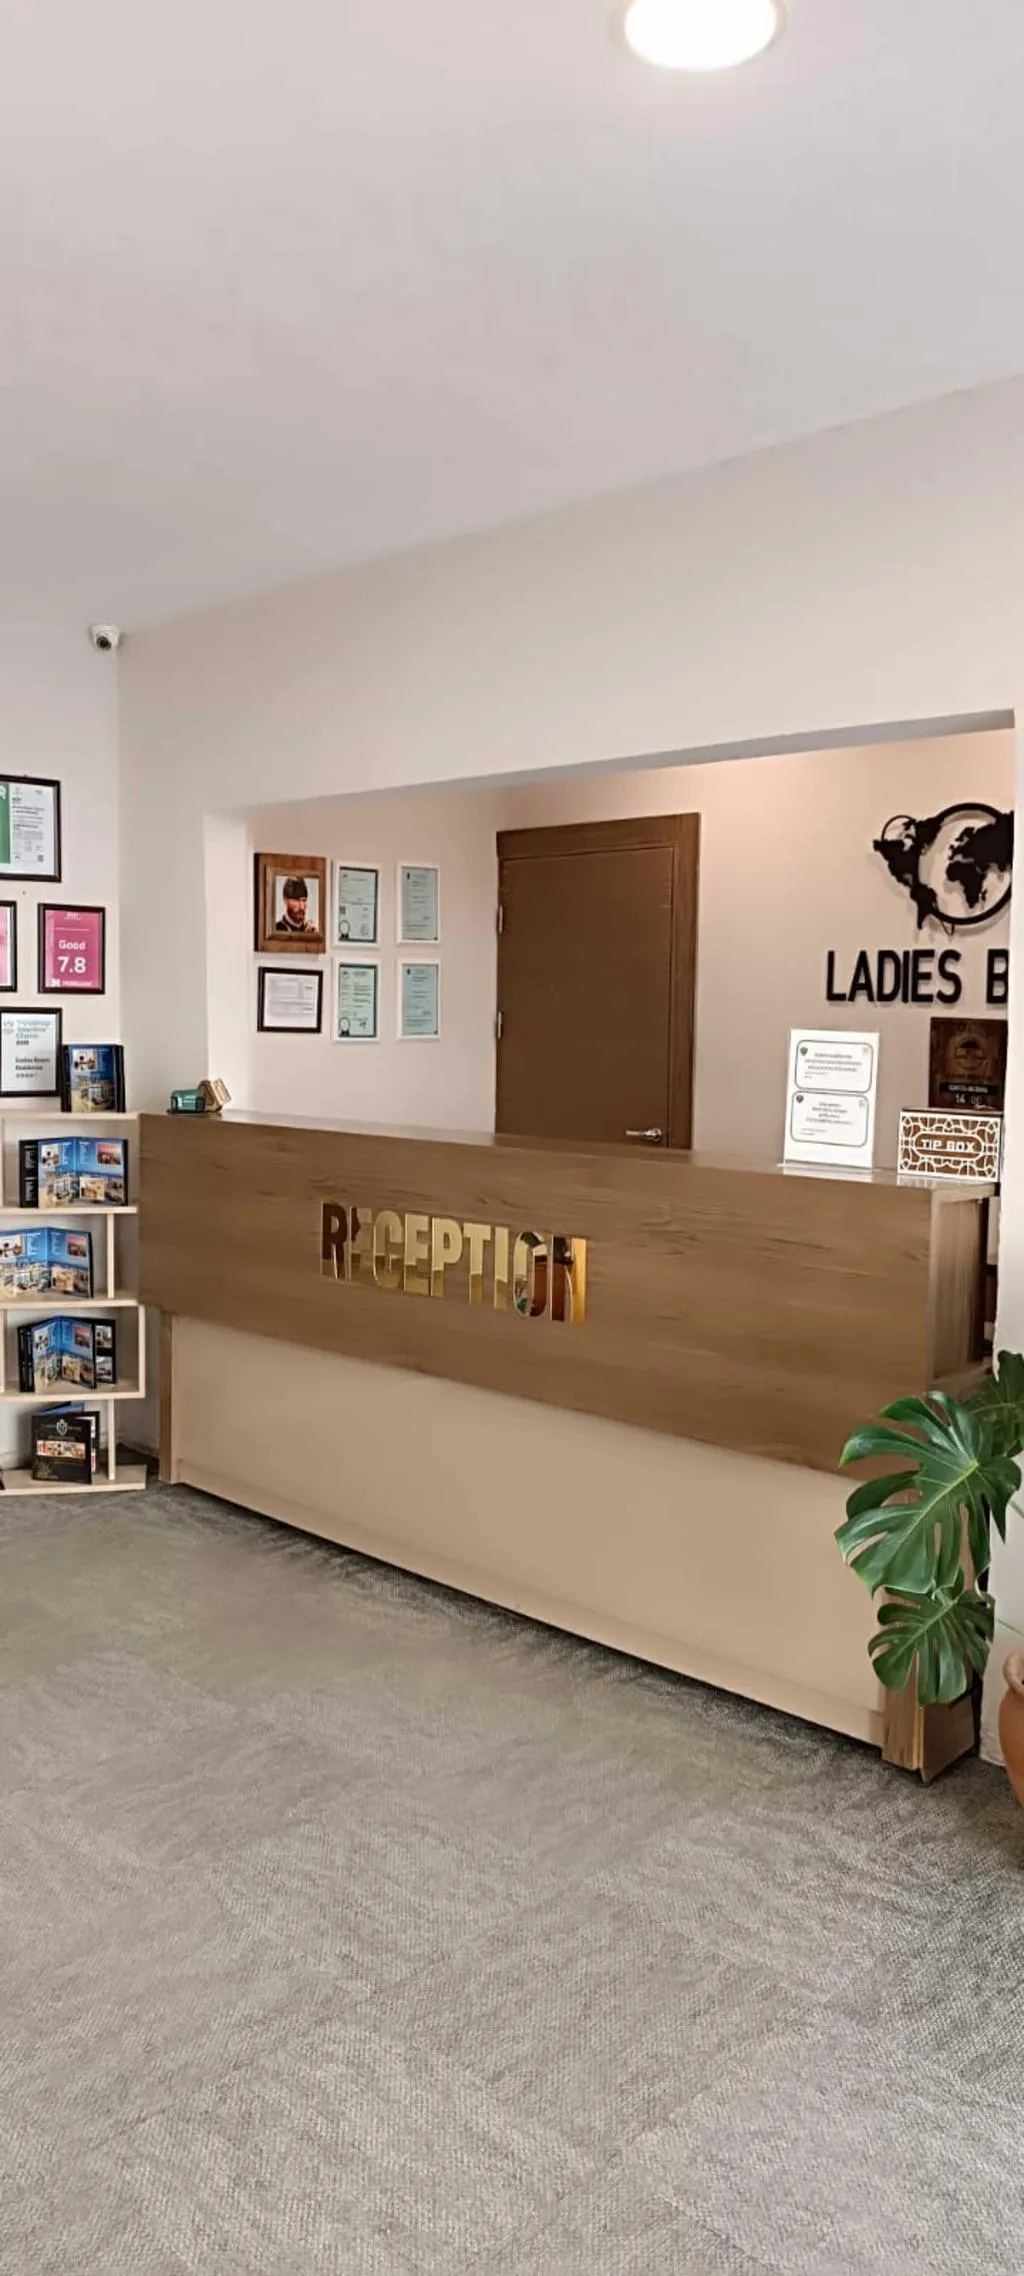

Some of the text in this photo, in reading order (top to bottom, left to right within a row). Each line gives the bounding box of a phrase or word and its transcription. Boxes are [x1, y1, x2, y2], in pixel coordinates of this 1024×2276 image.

[58, 939, 87, 951] Good
[57, 956, 87, 974] 7.8
[826, 949, 962, 1004] LADIES
[921, 1139, 975, 1152] TIP BOX
[320, 1202, 587, 1324] RECEPTION
